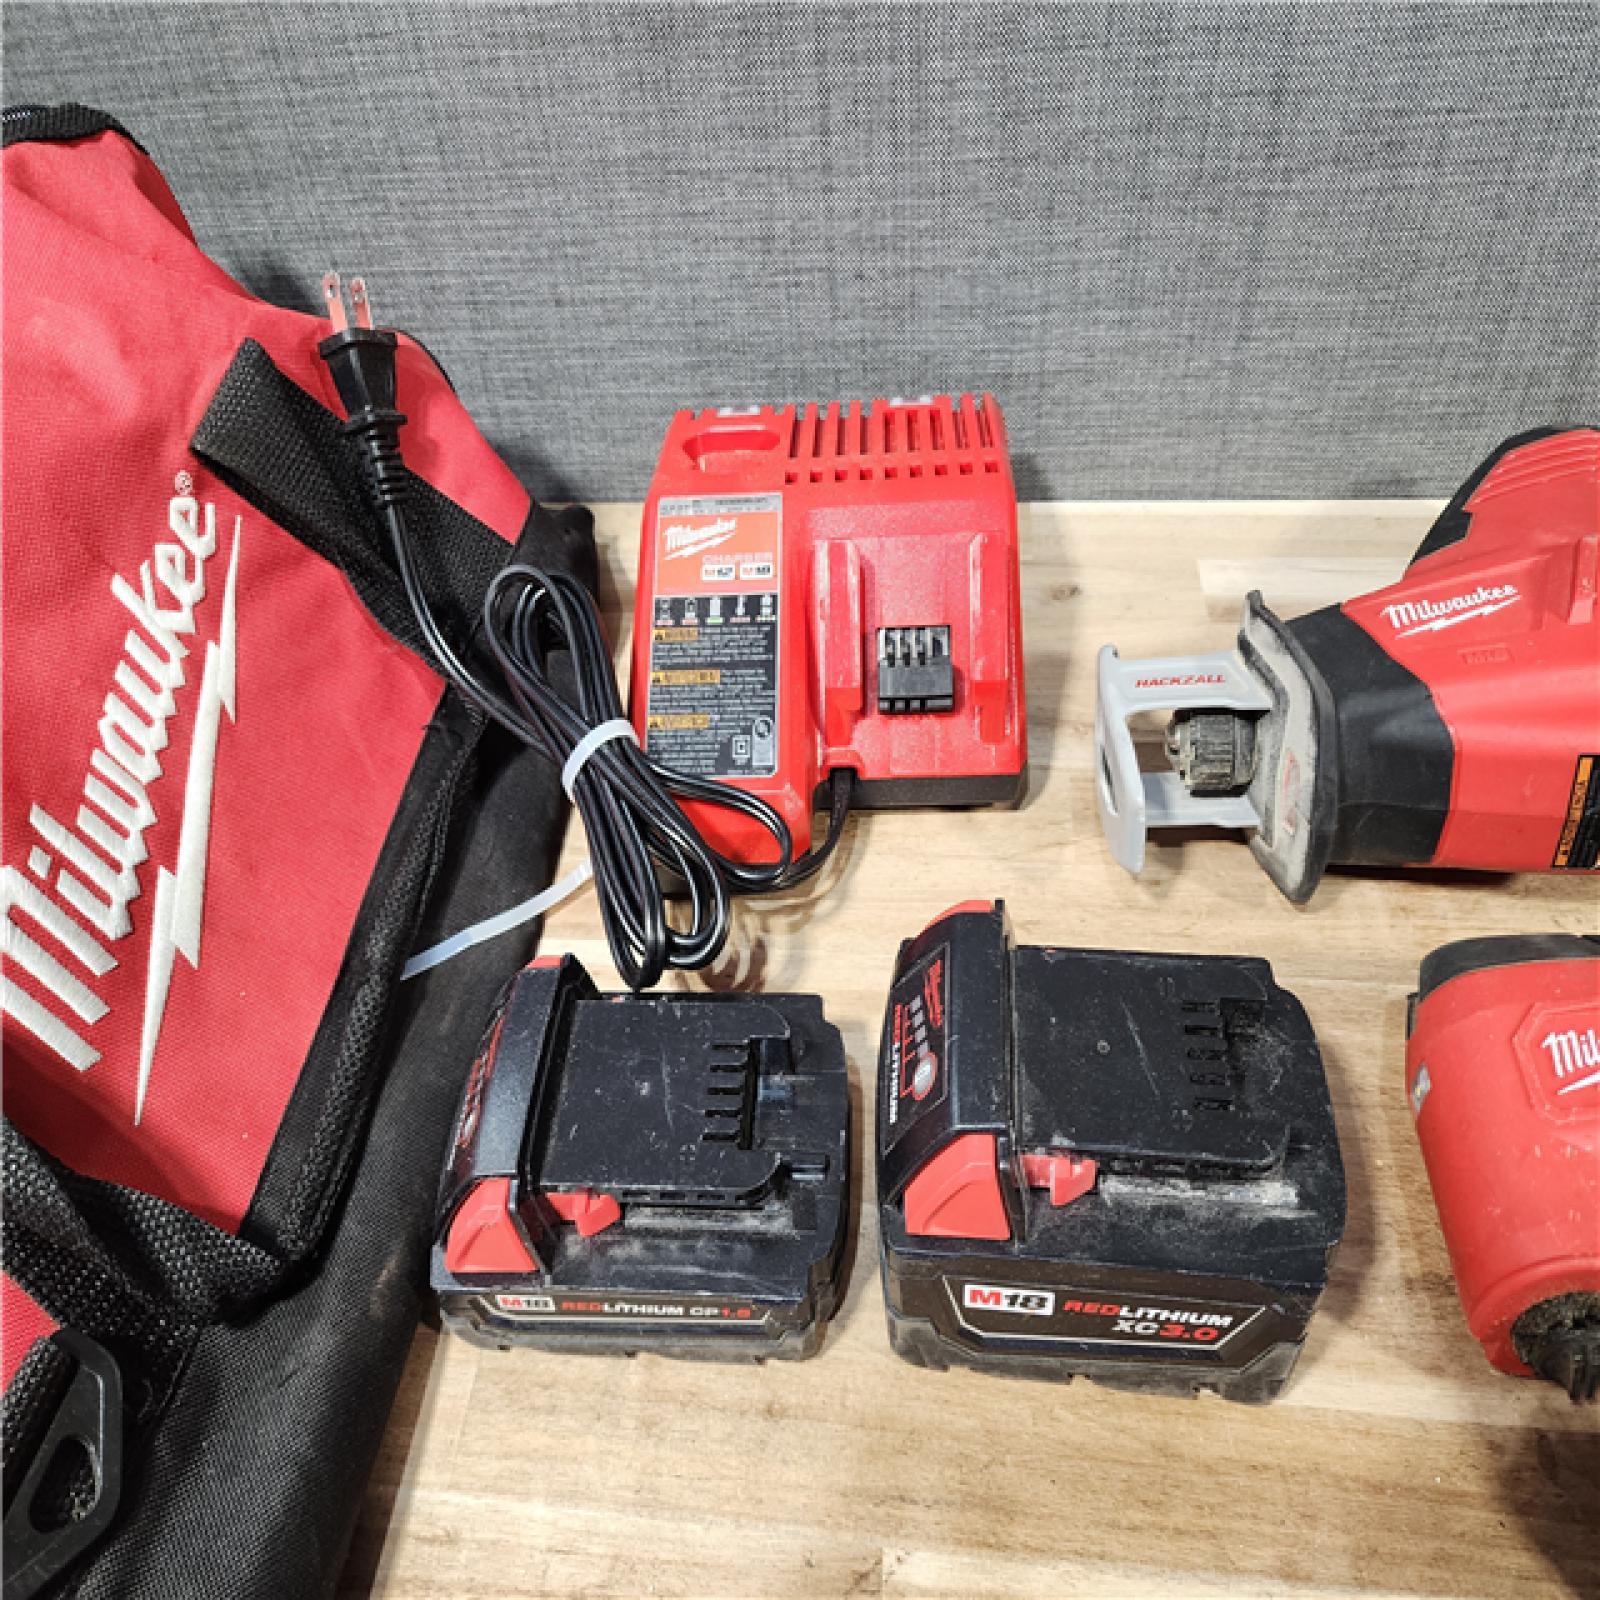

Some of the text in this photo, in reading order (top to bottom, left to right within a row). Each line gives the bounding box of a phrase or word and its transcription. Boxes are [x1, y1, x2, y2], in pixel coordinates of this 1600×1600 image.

[1380, 584, 1518, 628] Milwaukee
[1135, 674, 1225, 688] HACKZALL
[0, 496, 216, 1073] Milwaukee
[560, 1302, 684, 1317] REDLITHIUM
[969, 1289, 1233, 1328] M18 REDLITHIUM
